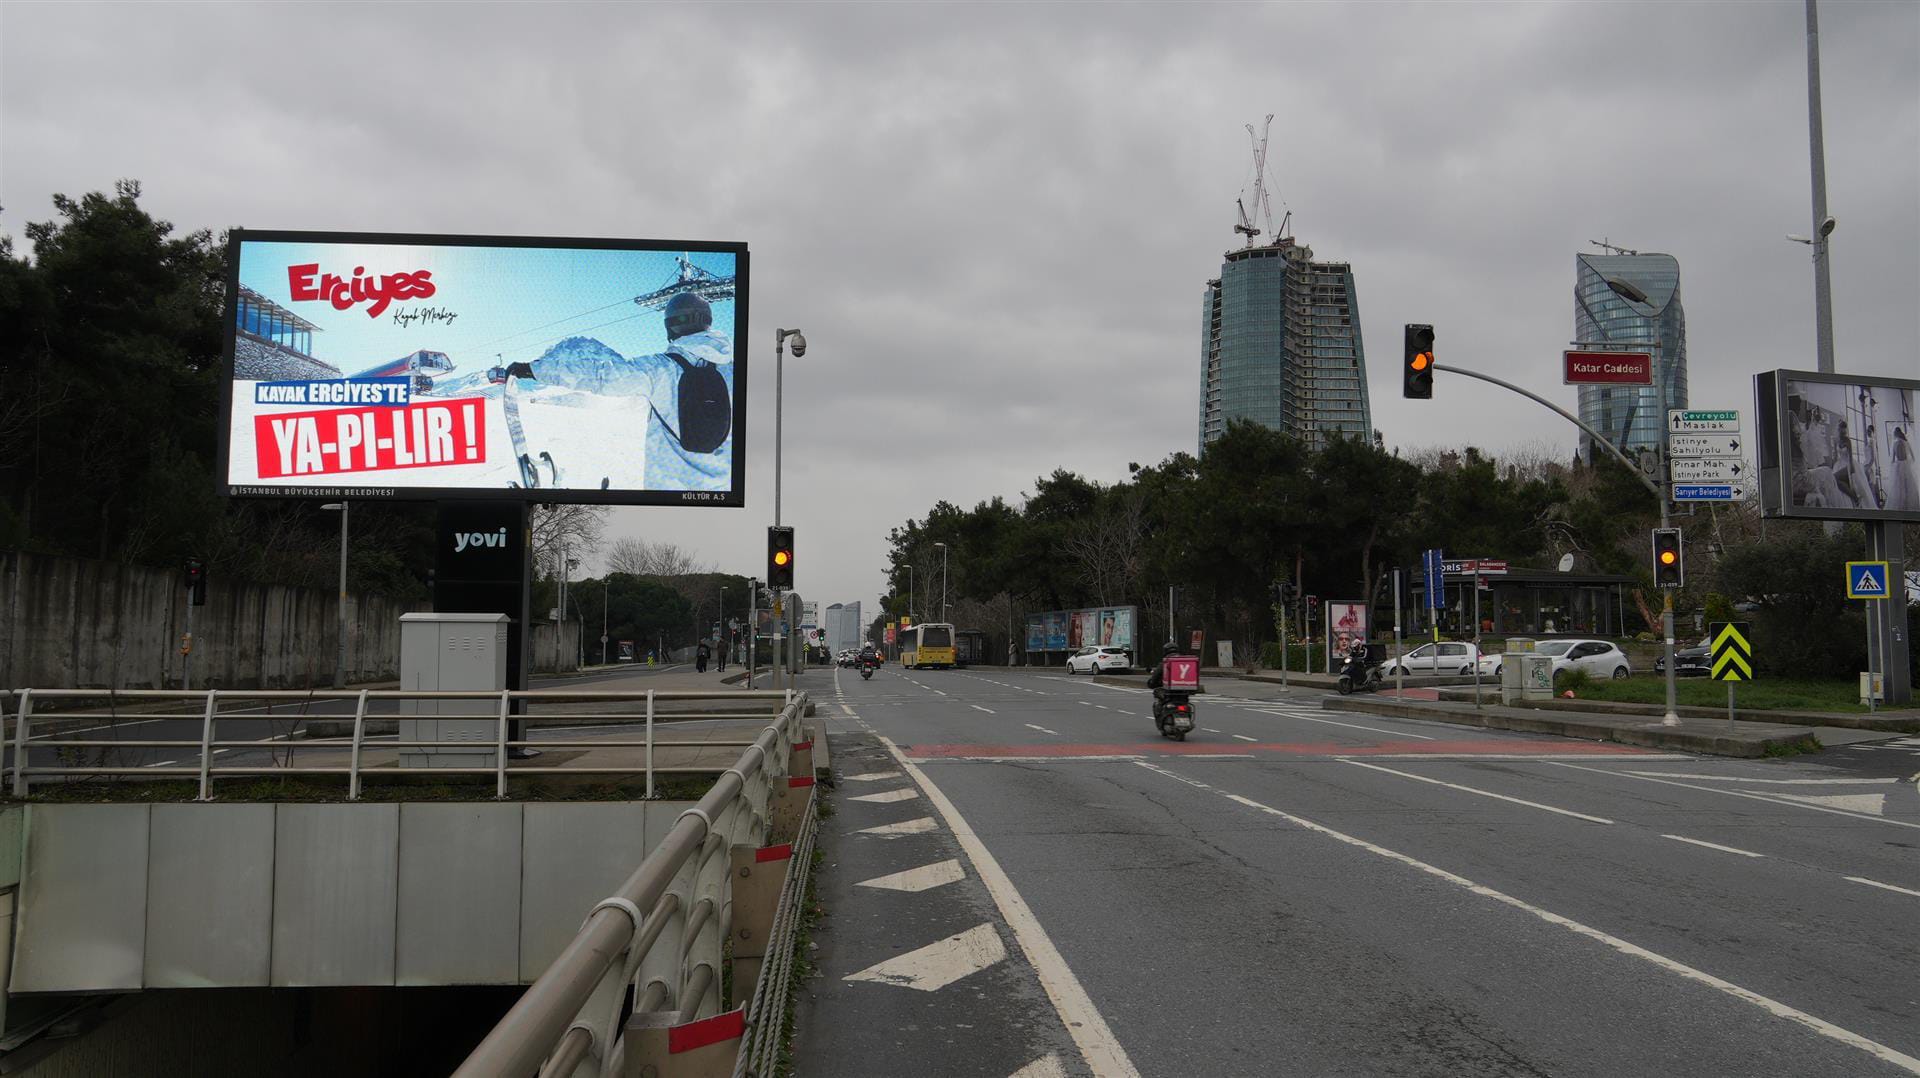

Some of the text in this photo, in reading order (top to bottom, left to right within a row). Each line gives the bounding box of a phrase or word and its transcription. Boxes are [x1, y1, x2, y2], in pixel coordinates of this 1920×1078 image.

[287, 263, 436, 319] Erciyes
[393, 306, 419, 328] Kayak
[1573, 363, 1643, 374] Katar Caddesi
[258, 379, 408, 403] KAYAK ERCİYES'TE
[1682, 411, 1736, 420] Çevreyolu
[271, 406, 455, 476] YA-PI-LIR
[1672, 446, 1721, 455] Sahilyolu
[1703, 460, 1727, 468] Mah.
[1702, 470, 1720, 478] Park
[239, 486, 281, 495] İSTANBUL
[284, 487, 341, 496] BÜYÜKŞEHİR
[682, 491, 710, 500] KÜLTÜR
[1699, 487, 1731, 498] Belediyesi
[454, 527, 507, 553] yovi
